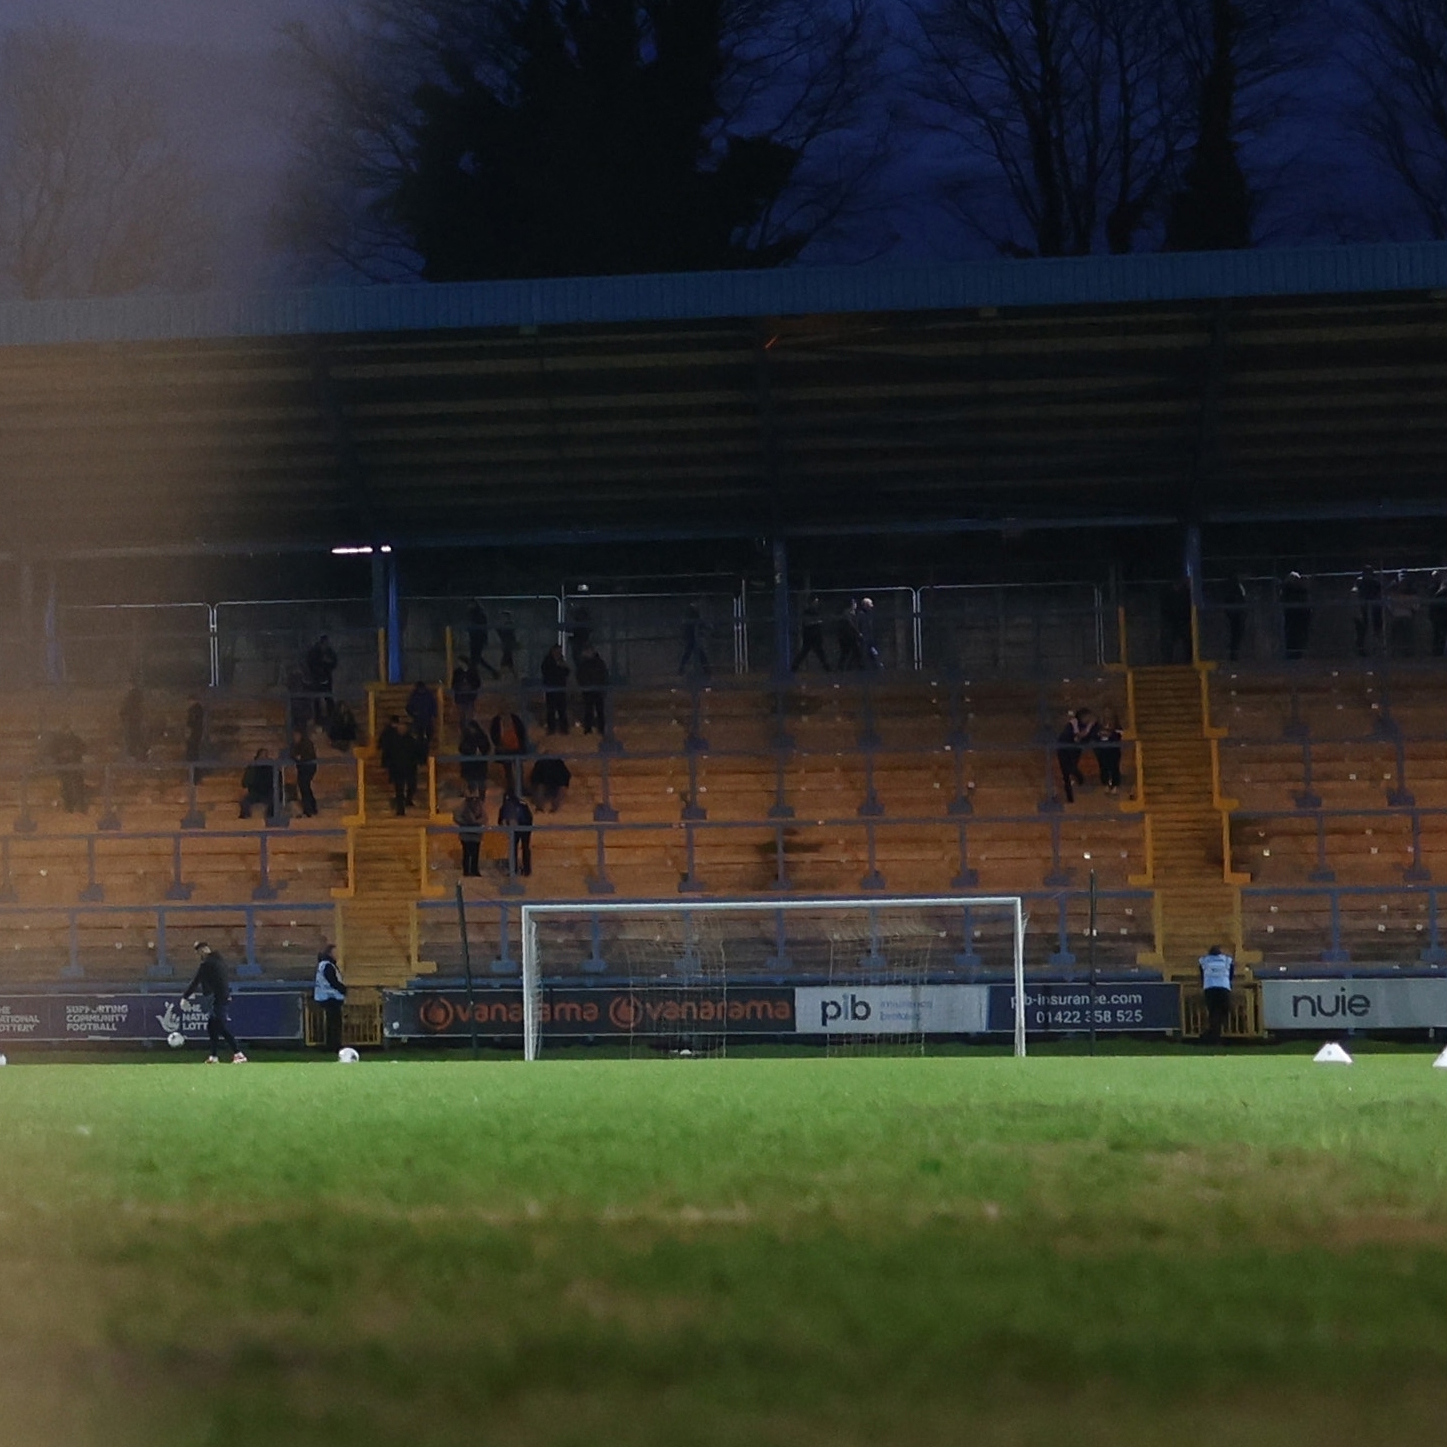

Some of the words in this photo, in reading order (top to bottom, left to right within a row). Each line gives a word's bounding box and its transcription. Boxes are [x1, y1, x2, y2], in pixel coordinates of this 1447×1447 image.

[1011, 993, 1144, 1009] pb-insurane.com
[1292, 987, 1371, 1018] nuie
[66, 1013, 128, 1023] COMMUNITY
[455, 1000, 599, 1022] vanaama
[645, 999, 791, 1021] vanarama
[821, 994, 872, 1027] pib
[1036, 1010, 1082, 1024] 01422
[1116, 1009, 1144, 1023] 525
[66, 1022, 117, 1032] FOOTBALL
[182, 1022, 209, 1031] LOTT
